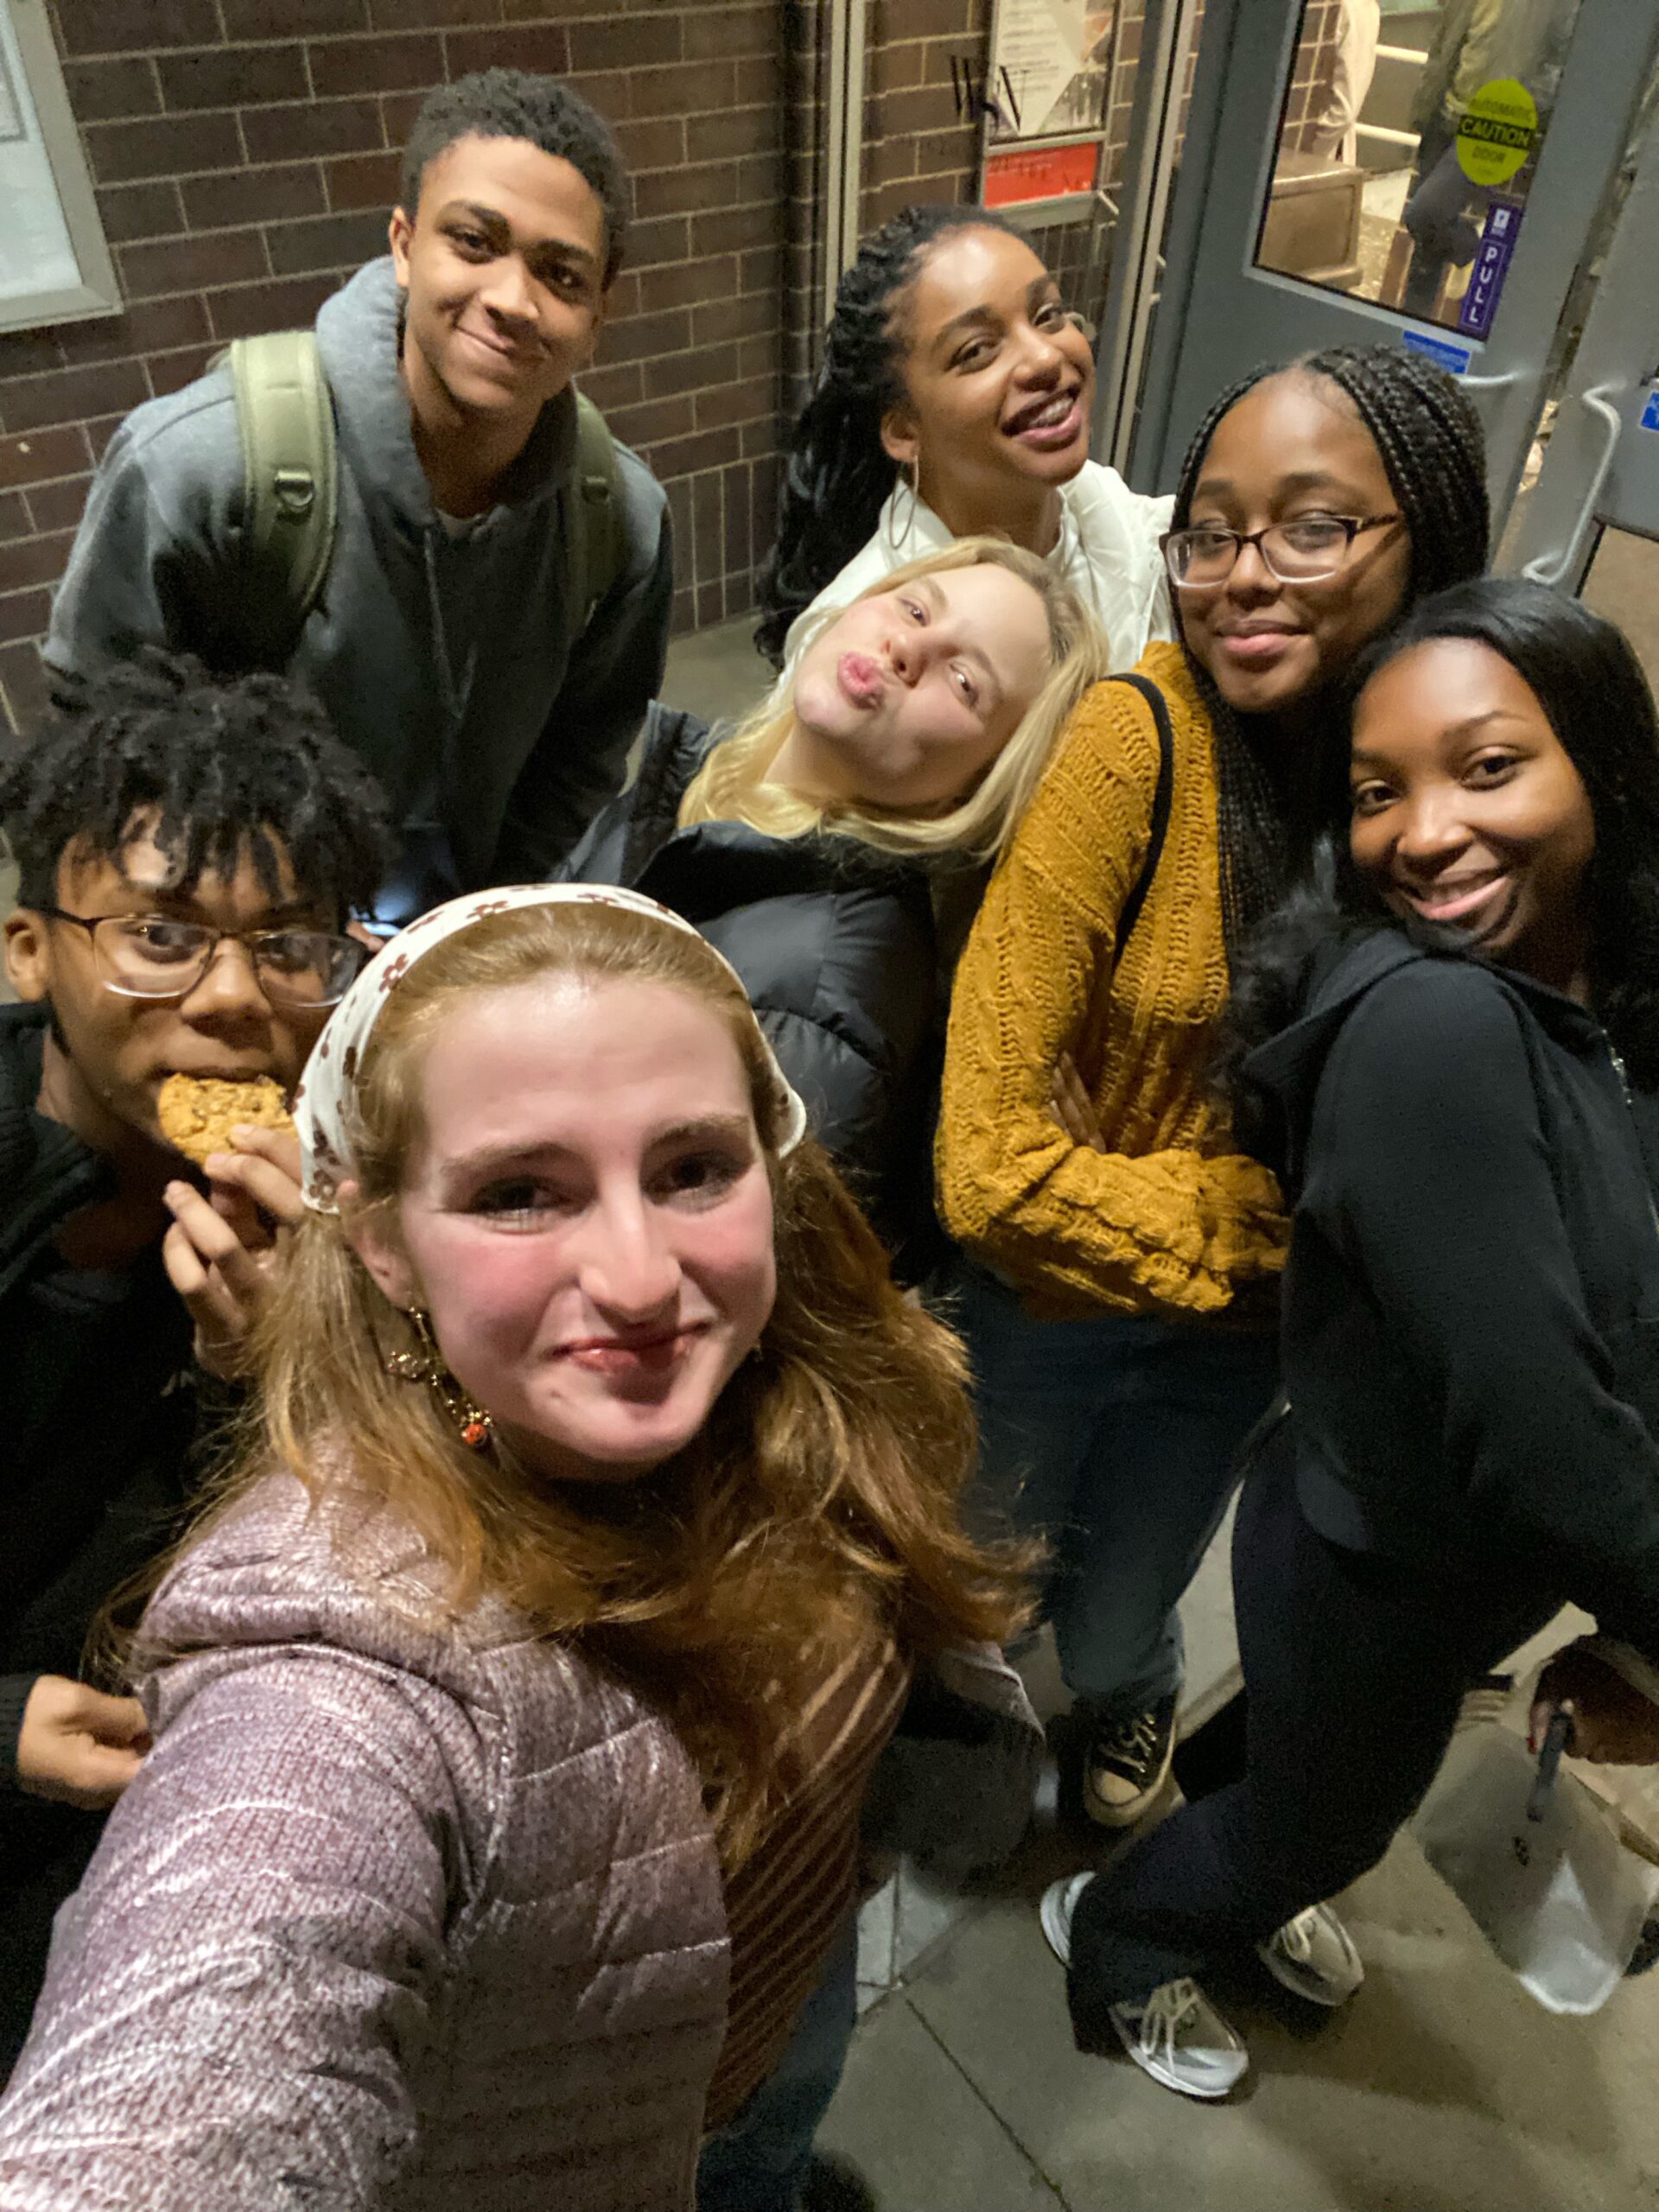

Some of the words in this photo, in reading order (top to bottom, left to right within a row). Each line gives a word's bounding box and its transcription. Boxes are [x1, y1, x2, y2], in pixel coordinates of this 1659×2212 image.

[1462, 118, 1530, 147] CAUTION
[1471, 145, 1506, 163] DOOR
[1469, 246, 1498, 323] PULL
